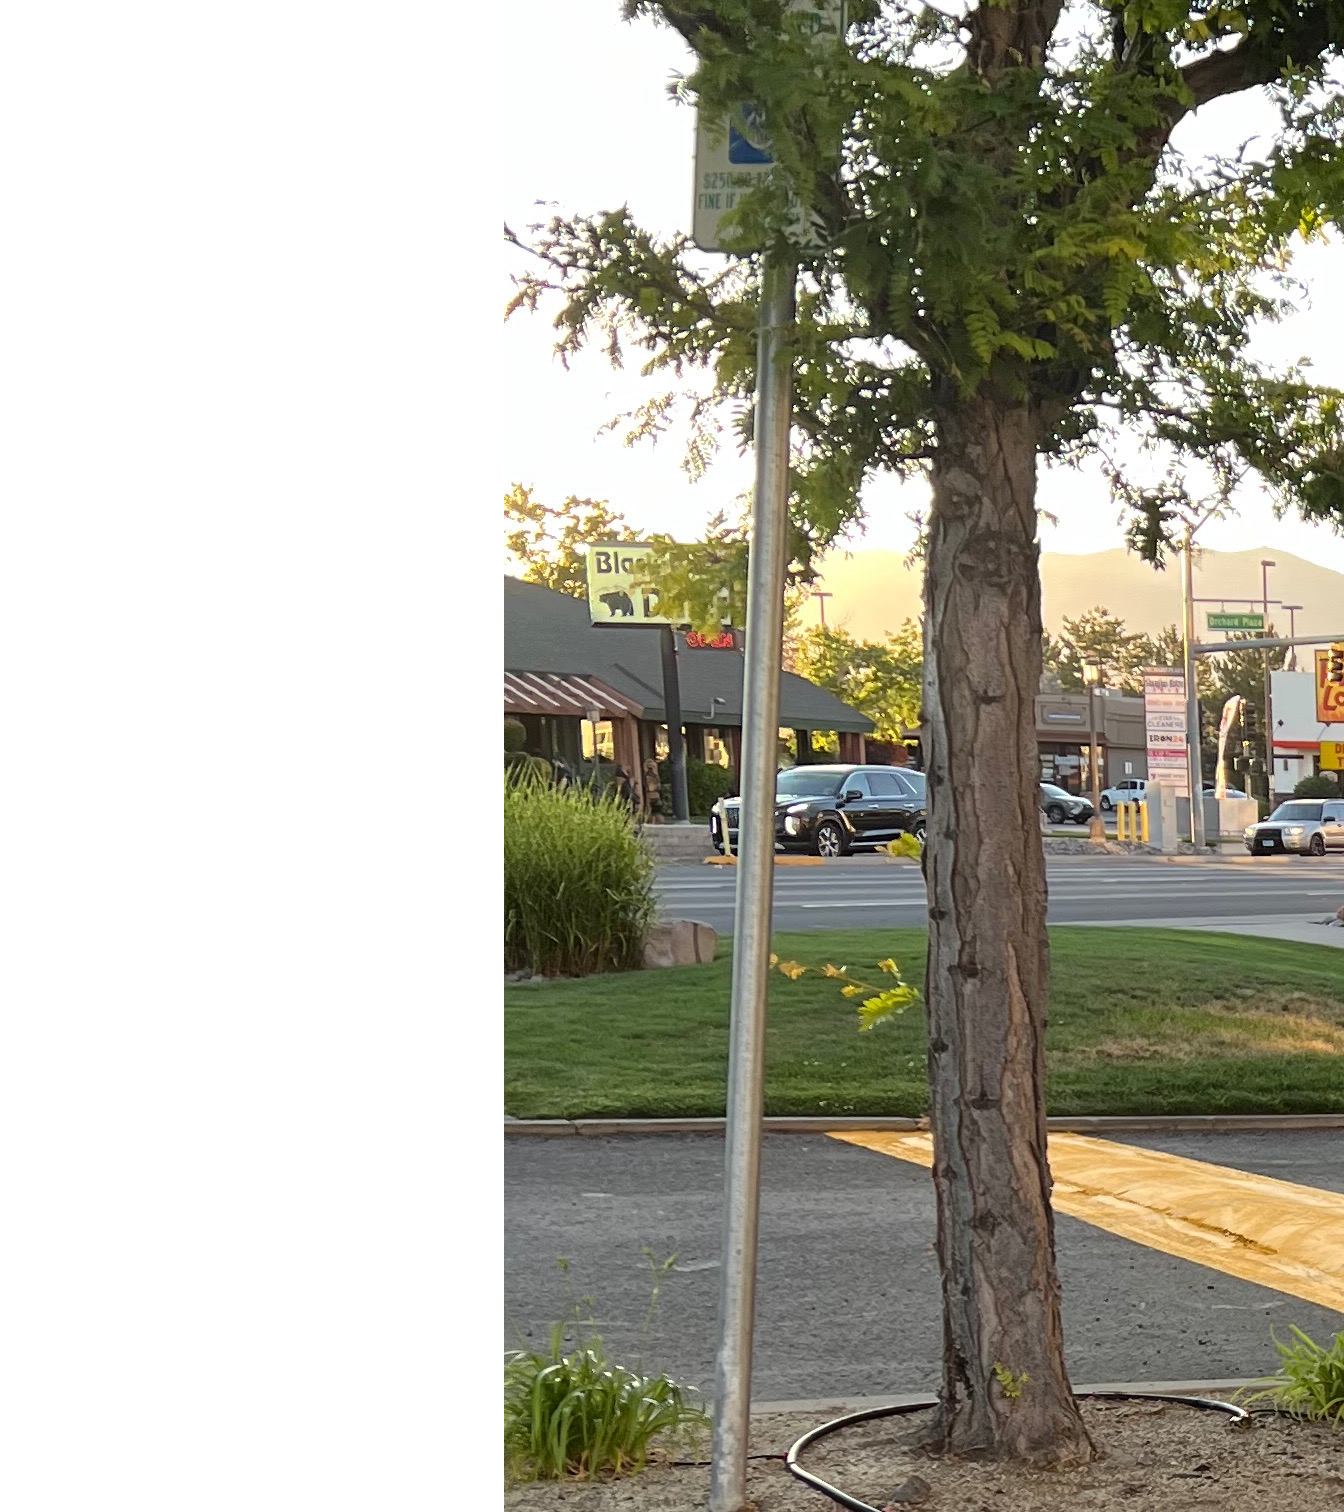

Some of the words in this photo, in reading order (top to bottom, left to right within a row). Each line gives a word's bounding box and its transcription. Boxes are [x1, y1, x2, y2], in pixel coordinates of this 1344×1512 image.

[698, 193, 721, 209] FINE
[725, 193, 737, 209] IF
[1209, 616, 1239, 627] Orchard
[1242, 617, 1263, 627] Plaza
[686, 632, 734, 648] OPN
